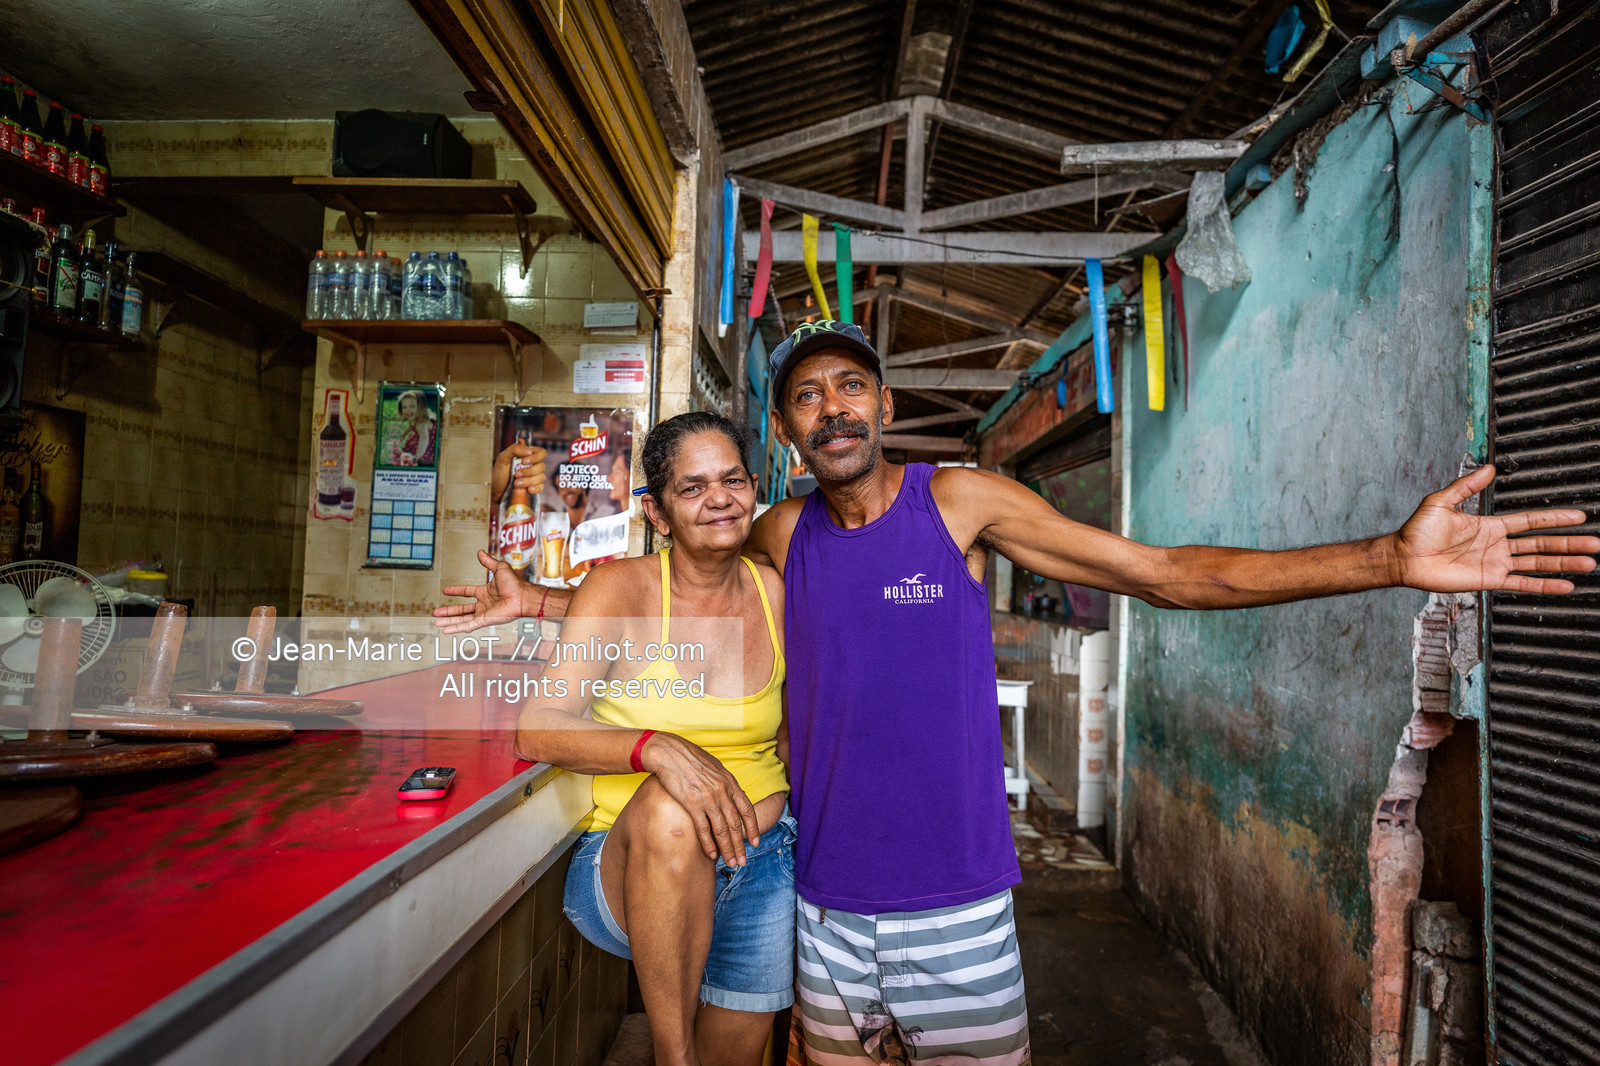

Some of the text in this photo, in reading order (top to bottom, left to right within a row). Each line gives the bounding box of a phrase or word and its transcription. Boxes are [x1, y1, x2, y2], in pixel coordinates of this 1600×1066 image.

[571, 435, 606, 457] SCHIN
[559, 464, 599, 475] BOTECO
[567, 481, 588, 489] POVO
[589, 482, 614, 490] GOSTA.
[572, 474, 590, 482] JEITO
[500, 521, 537, 549] SCHIN
[884, 584, 944, 599] HOLLISTER
[92, 667, 127, 683] SÃO
[83, 685, 114, 700] JOR
